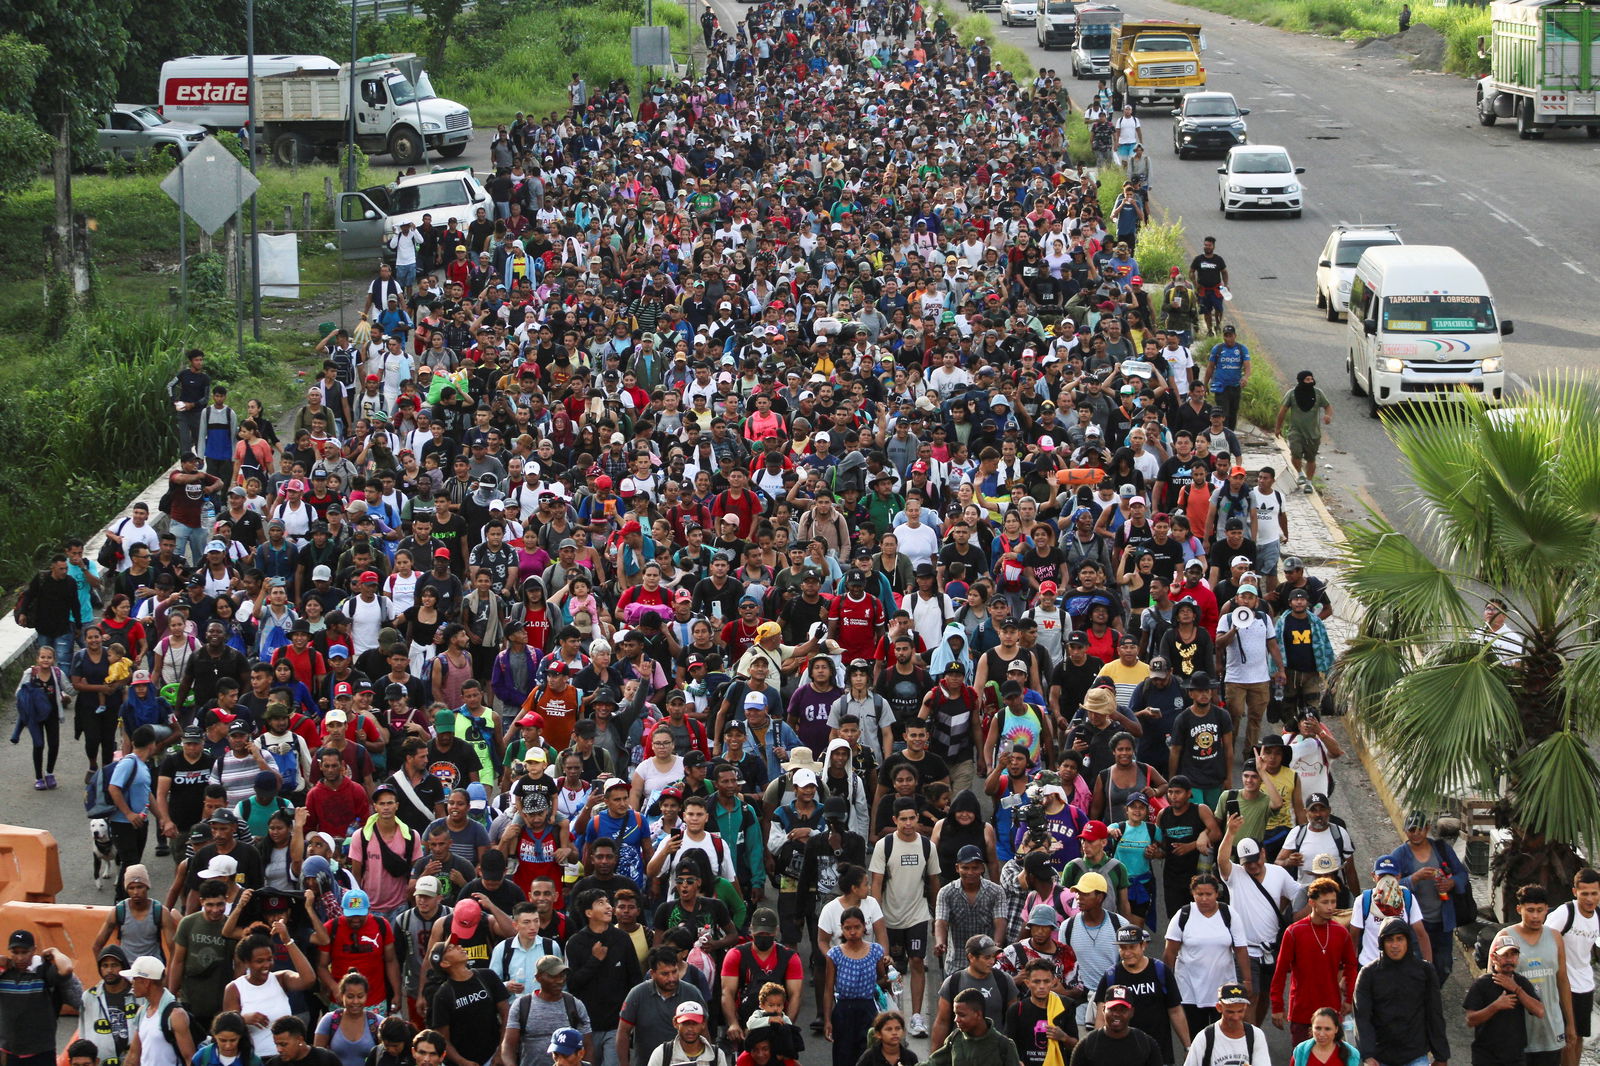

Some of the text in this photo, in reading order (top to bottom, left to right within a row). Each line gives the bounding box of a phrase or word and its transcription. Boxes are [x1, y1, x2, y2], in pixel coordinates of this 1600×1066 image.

[1043, 620, 1056, 629] W
[1292, 630, 1311, 644] M
[805, 704, 832, 722] GA
[174, 775, 212, 784] OWLS
[1312, 794, 1320, 802] LA
[558, 1034, 566, 1043] NY
